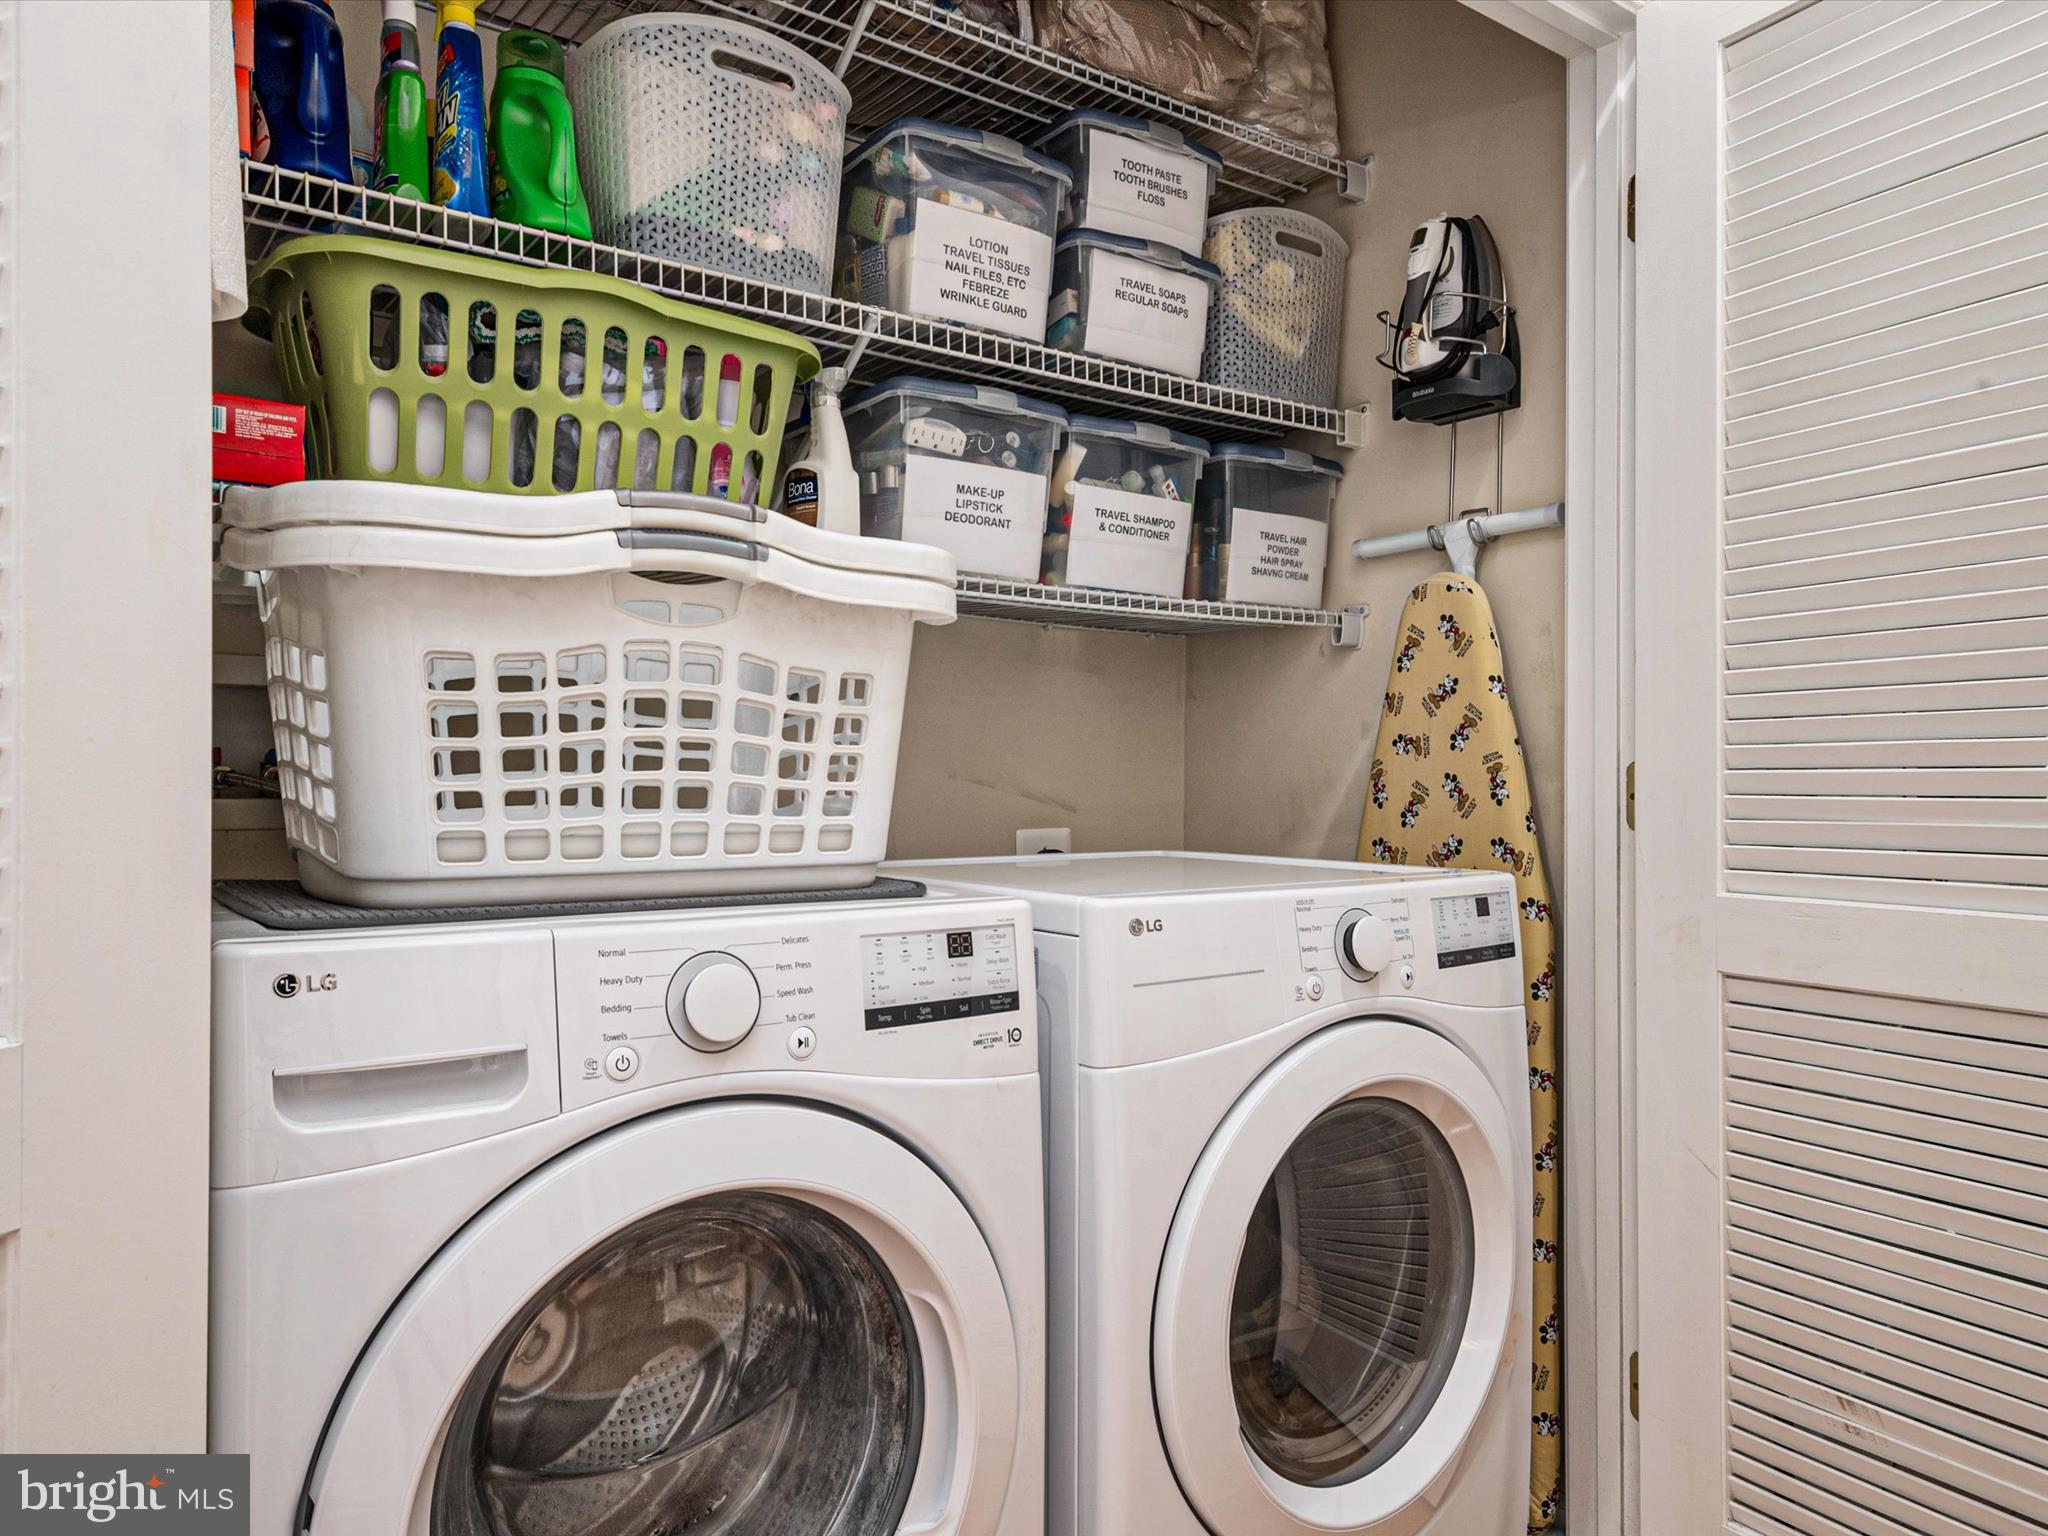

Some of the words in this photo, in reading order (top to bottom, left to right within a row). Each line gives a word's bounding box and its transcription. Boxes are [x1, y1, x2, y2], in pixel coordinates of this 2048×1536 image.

[1121, 158, 1153, 176] TOOTH
[1155, 168, 1182, 185] PASTE
[1113, 170, 1145, 187] TOOTH
[1147, 179, 1188, 200] BRUSHES
[1137, 190, 1165, 207] FLOSS
[969, 236, 1009, 256] LOTION
[943, 243, 985, 265] TRAVEL
[988, 255, 1030, 276] TISSUES
[945, 259, 970, 275] NAIL
[973, 267, 1004, 286] FILES,
[1007, 276, 1026, 290] ETC
[963, 278, 1009, 300] FEBREZE
[1120, 276, 1156, 295] TRAVEL
[1159, 287, 1186, 304] SOAPS
[940, 287, 990, 309] WRINKLE
[992, 301, 1027, 319] GUARD
[1115, 289, 1160, 309] REGULAR
[1161, 301, 1189, 318] SOAPS
[788, 481, 814, 498] Bona
[956, 484, 1005, 499] MAKE-UP
[956, 498, 1003, 514] LIPSTICK
[944, 511, 1011, 529] DEODORANT
[1095, 507, 1130, 522] TRAVEL
[1133, 513, 1175, 529] SHAMPOO
[1099, 521, 1105, 531] &
[1108, 523, 1170, 541] CONDITIONER
[1260, 531, 1288, 543] TRAVEL
[1290, 536, 1307, 546] HAIR
[1267, 544, 1299, 557] POWDER
[1261, 556, 1279, 566] HAIR
[1280, 558, 1303, 569] SPRAY
[1251, 566, 1283, 579] SHAVNG
[1285, 570, 1309, 581] CREAM
[1146, 918, 1163, 933] LG
[781, 936, 809, 945] Delicates
[598, 948, 626, 957] Normal
[776, 963, 793, 971] Perm.
[795, 961, 812, 970] Press
[306, 973, 337, 992] LG
[600, 977, 623, 986] Heavy
[625, 975, 643, 985] Duty
[777, 988, 796, 998] Speed
[797, 986, 814, 995] Wash
[601, 1004, 632, 1014] Bedding
[920, 1006, 931, 1015] Spin
[959, 1004, 969, 1012] Soil
[785, 1014, 797, 1023] Tub
[798, 1013, 816, 1021] Clean
[602, 1032, 628, 1042] Towels
[1007, 1027, 1022, 1043] 10
